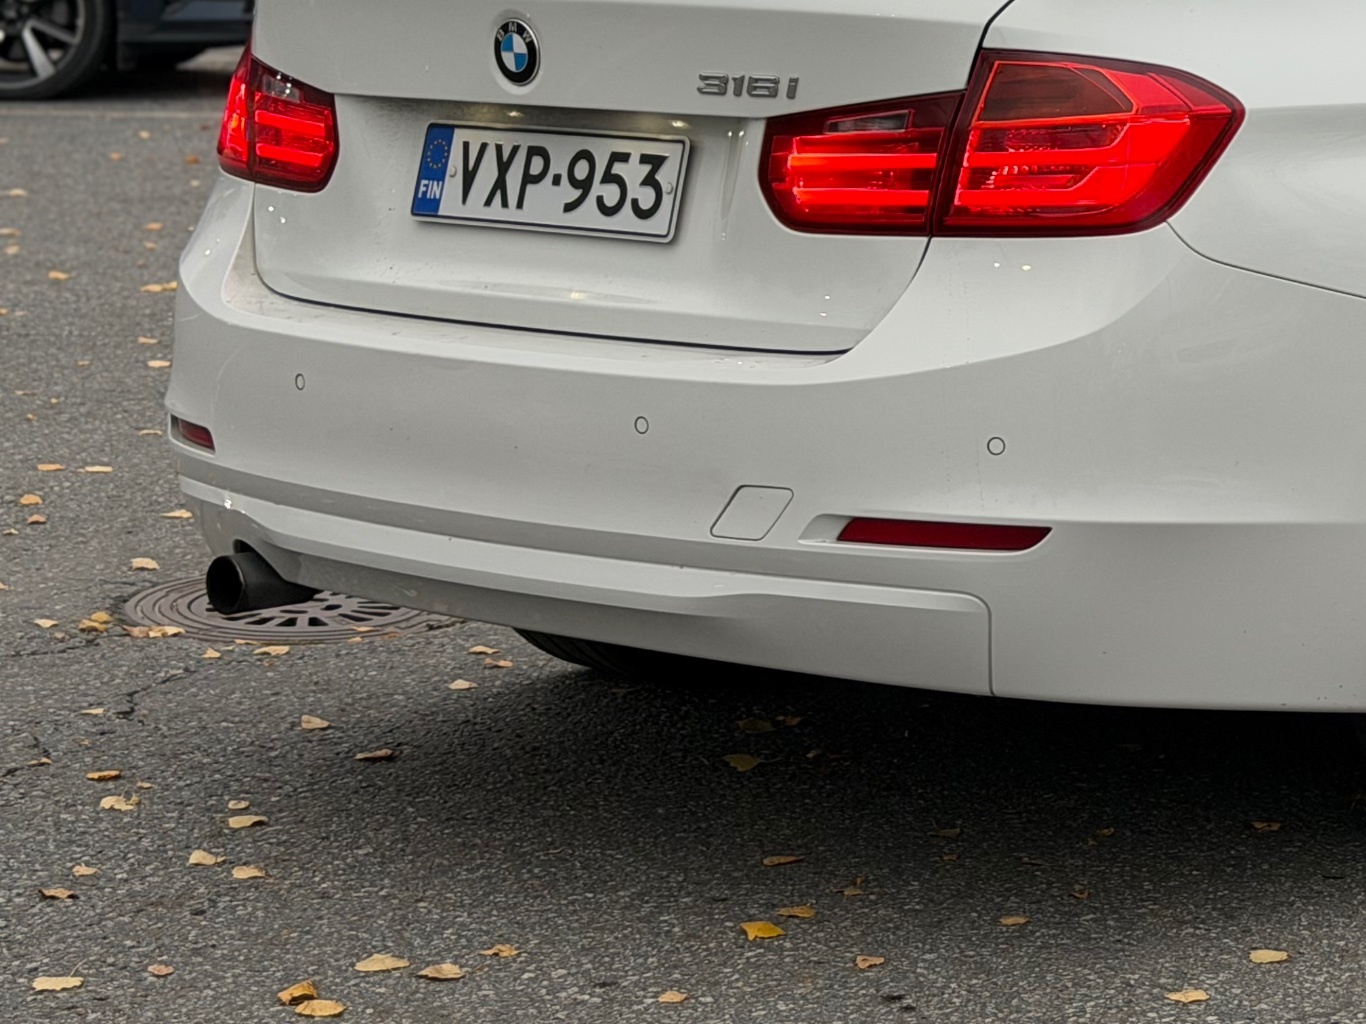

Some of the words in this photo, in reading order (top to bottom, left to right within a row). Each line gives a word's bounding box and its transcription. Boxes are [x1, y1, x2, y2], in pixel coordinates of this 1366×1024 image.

[496, 21, 533, 43] BMW
[696, 72, 800, 100] 316i
[417, 179, 443, 200] FIN
[461, 140, 670, 220] VXP-953
